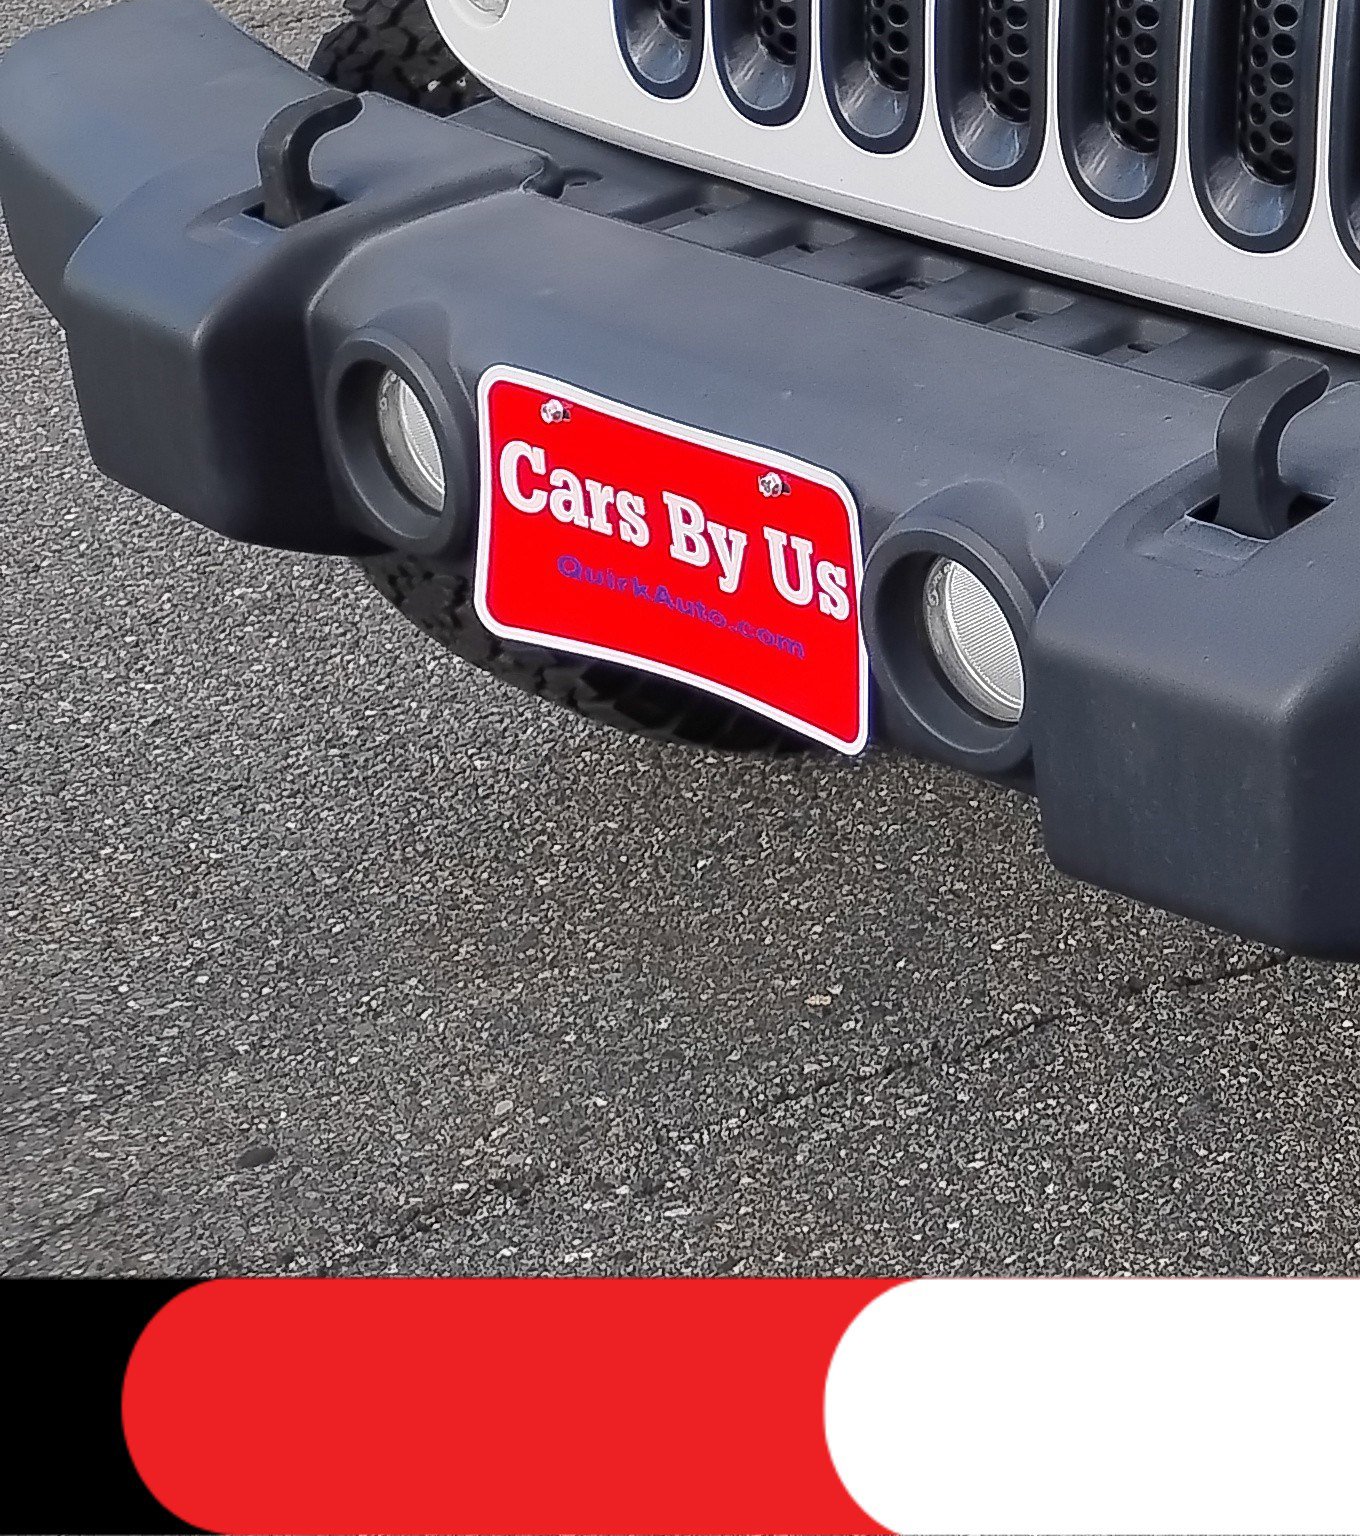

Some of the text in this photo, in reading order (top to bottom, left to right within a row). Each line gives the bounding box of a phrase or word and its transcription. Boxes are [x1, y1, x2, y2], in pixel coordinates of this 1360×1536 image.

[500, 440, 850, 620] Cars By Us
[556, 555, 805, 659] QuirkAuto.com
